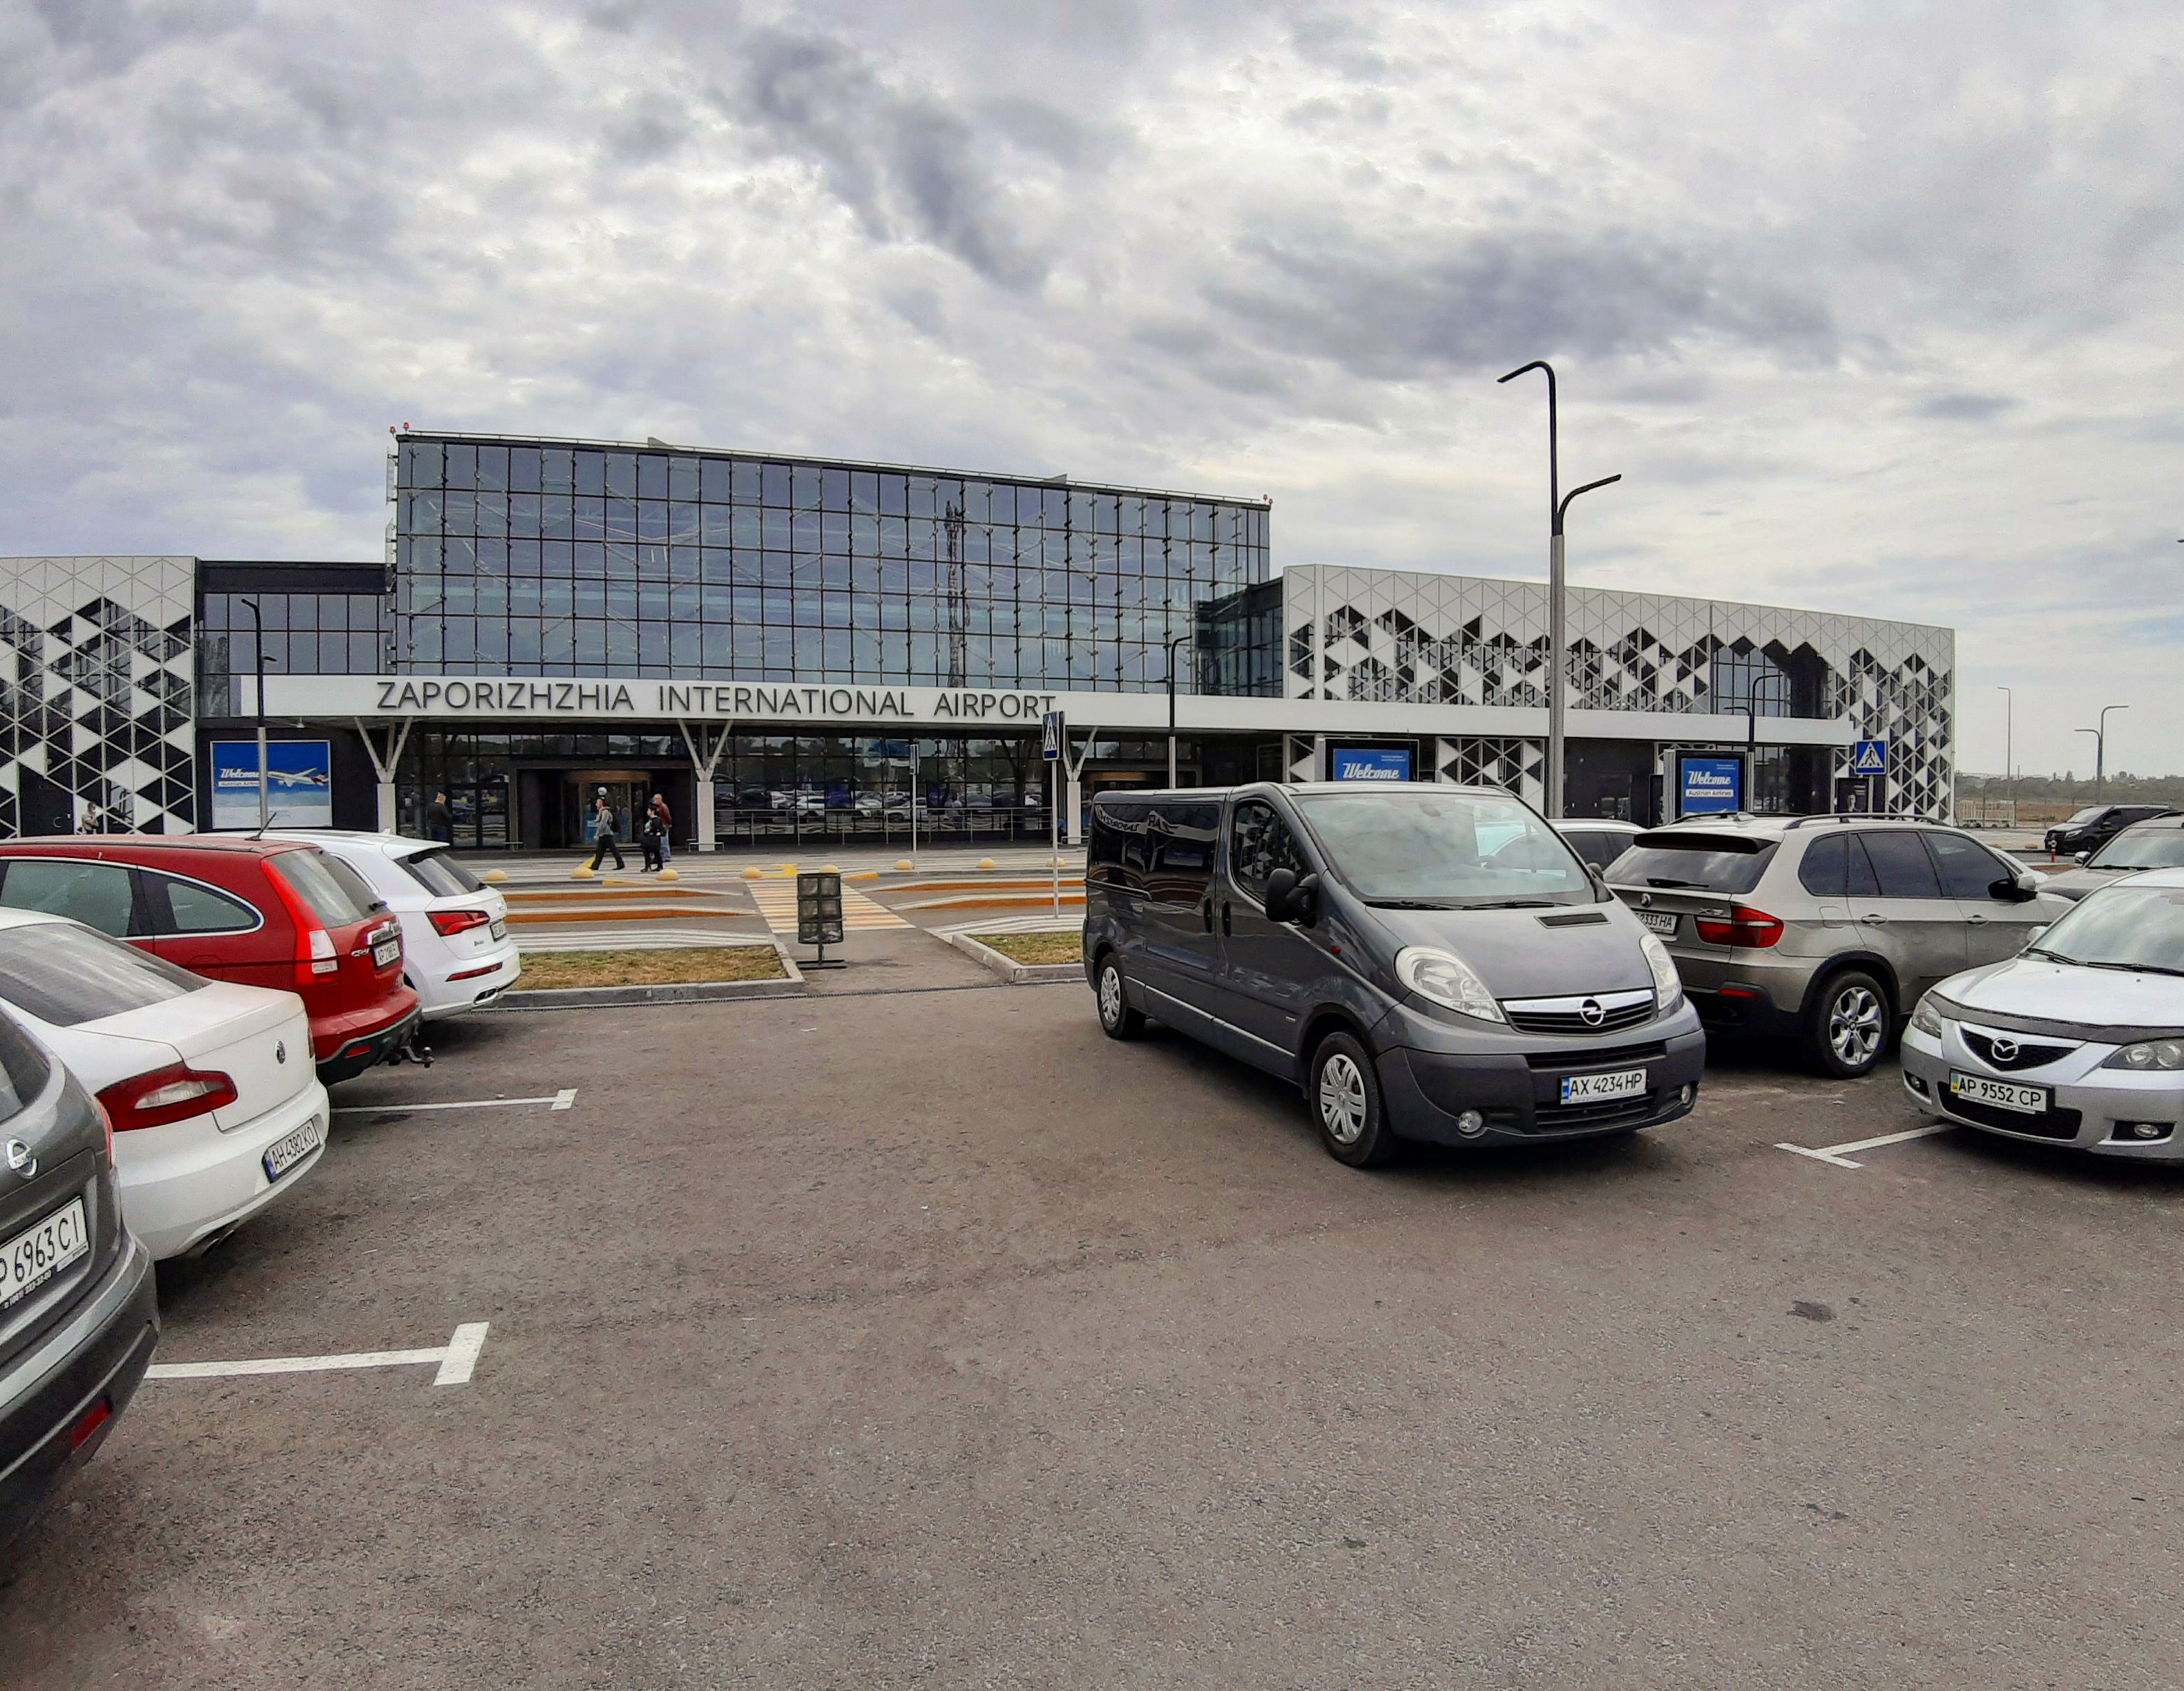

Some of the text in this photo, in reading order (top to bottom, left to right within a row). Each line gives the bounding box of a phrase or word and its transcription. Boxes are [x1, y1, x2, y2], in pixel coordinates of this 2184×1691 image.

[376, 681, 1056, 718] ZAPORIZHZHIA INTERNATIONAL AIRPORT
[1342, 762, 1400, 779] Welcome
[1687, 770, 1732, 785] Welcome
[1659, 915, 1672, 928] HA
[1569, 1072, 1642, 1096] AX 4234 HP
[1958, 1077, 1977, 1093] AP
[1981, 1082, 2014, 1103] 9552
[2019, 1090, 2041, 1107] CP
[272, 1126, 315, 1170] AH 4382 KO
[15, 1225, 55, 1282] 6963
[58, 1210, 79, 1250] CI
